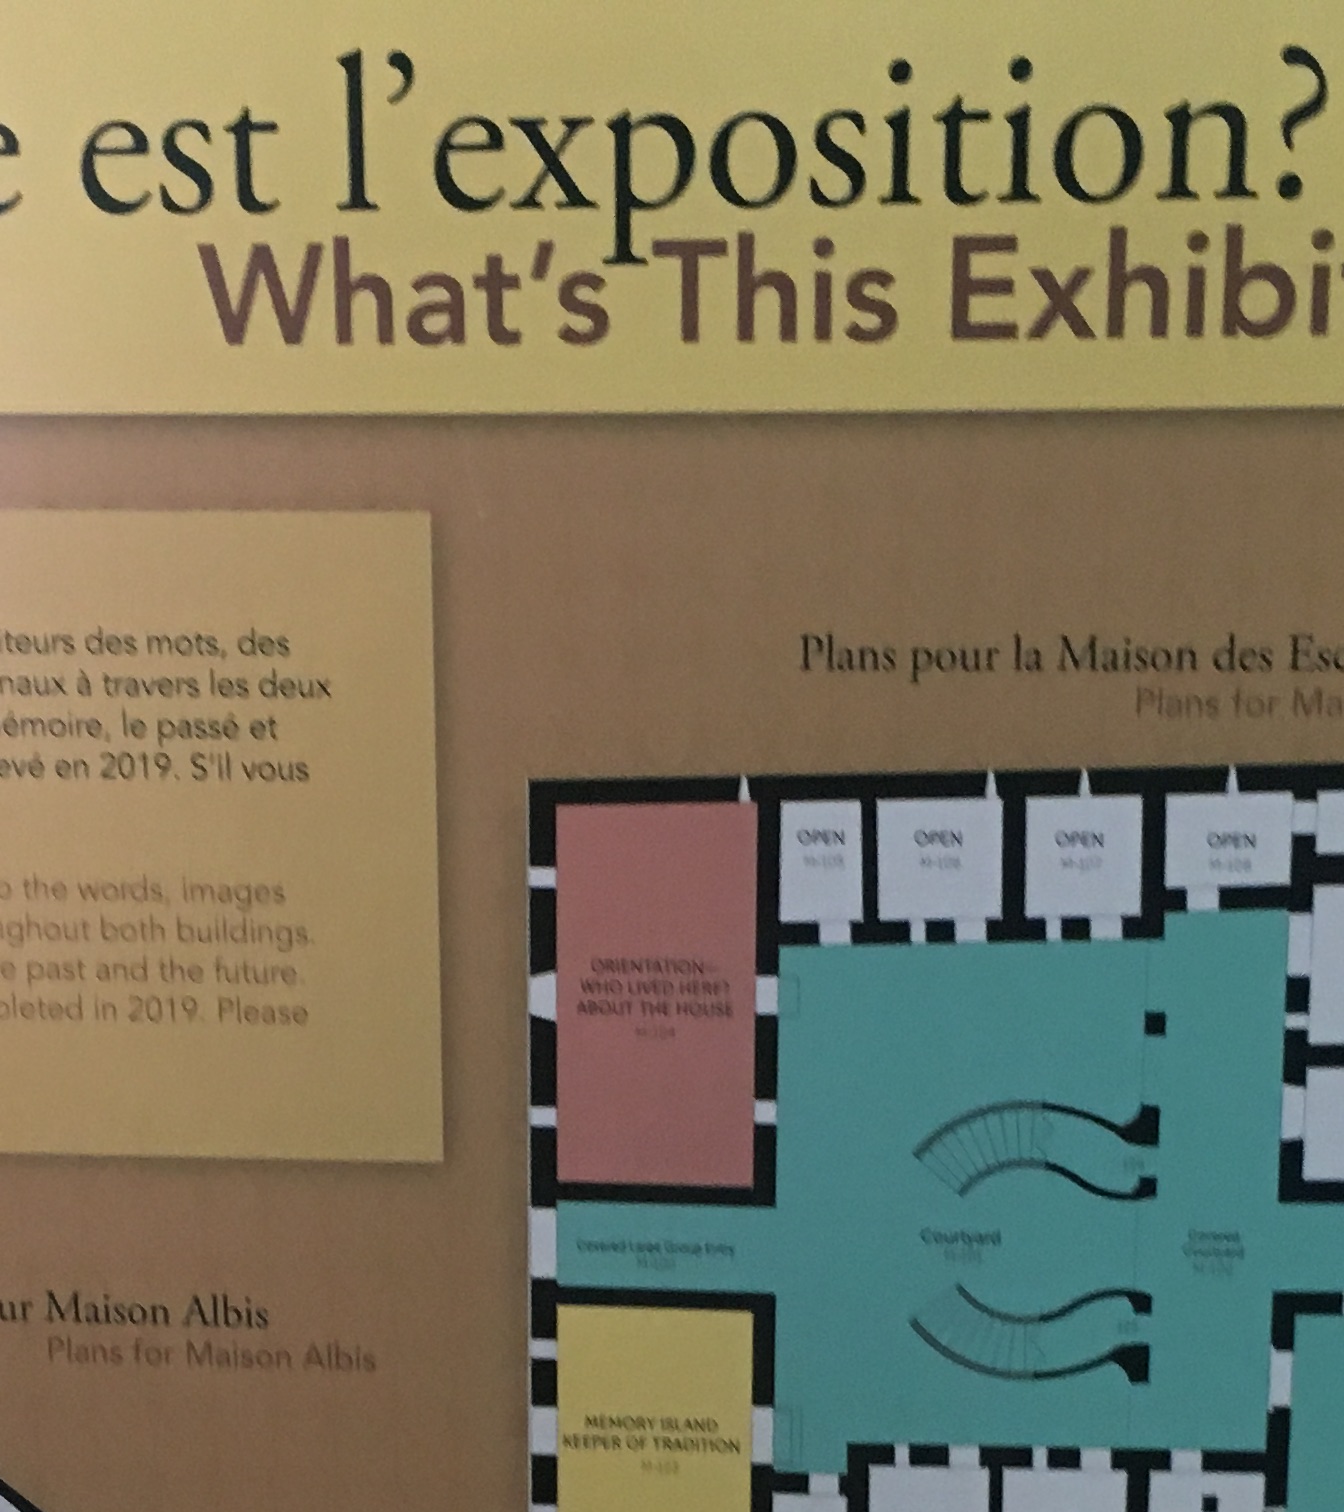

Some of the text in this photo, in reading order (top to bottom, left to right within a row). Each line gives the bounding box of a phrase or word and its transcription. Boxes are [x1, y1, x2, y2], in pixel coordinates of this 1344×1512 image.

[78, 110, 280, 218] est
[334, 46, 1335, 266] l'exposition?
[198, 232, 613, 349] What's
[653, 231, 899, 346] This
[83, 625, 139, 656] des
[145, 625, 227, 660] mots,
[236, 626, 291, 657] des
[798, 632, 899, 672] Plans
[908, 646, 1001, 682] pour
[1011, 632, 1046, 672] la
[1056, 632, 1200, 672] Maison
[1210, 632, 1275, 672] des
[75, 666, 94, 697] à
[101, 666, 202, 698] travers
[208, 668, 251, 698] les
[257, 668, 333, 699] deux
[1134, 686, 1221, 719] Plans
[1231, 686, 1277, 719] for
[120, 707, 148, 738] le
[155, 708, 242, 747] passé
[247, 713, 279, 740] et
[54, 757, 91, 779] en
[101, 749, 183, 781] 2019.
[189, 750, 233, 781] S'il
[241, 760, 311, 782] vous
[796, 829, 846, 848] OPEN
[914, 829, 964, 849] OPEN
[1055, 830, 1105, 849] OPEN
[1206, 831, 1258, 850] OPEN
[98, 914, 168, 944] both
[176, 916, 316, 955] buildings.
[92, 993, 120, 1022] in
[126, 994, 206, 1024] 2019.
[216, 993, 311, 1026] Please
[919, 1226, 1003, 1248] Courtyard
[46, 1287, 171, 1327] Maison
[186, 1291, 269, 1330] Albis
[45, 1335, 379, 1373] Plans for Maison Albis
[584, 1414, 720, 1434] MEMORY ISLAND
[561, 1432, 742, 1455] KEEPER OF TRADITION
